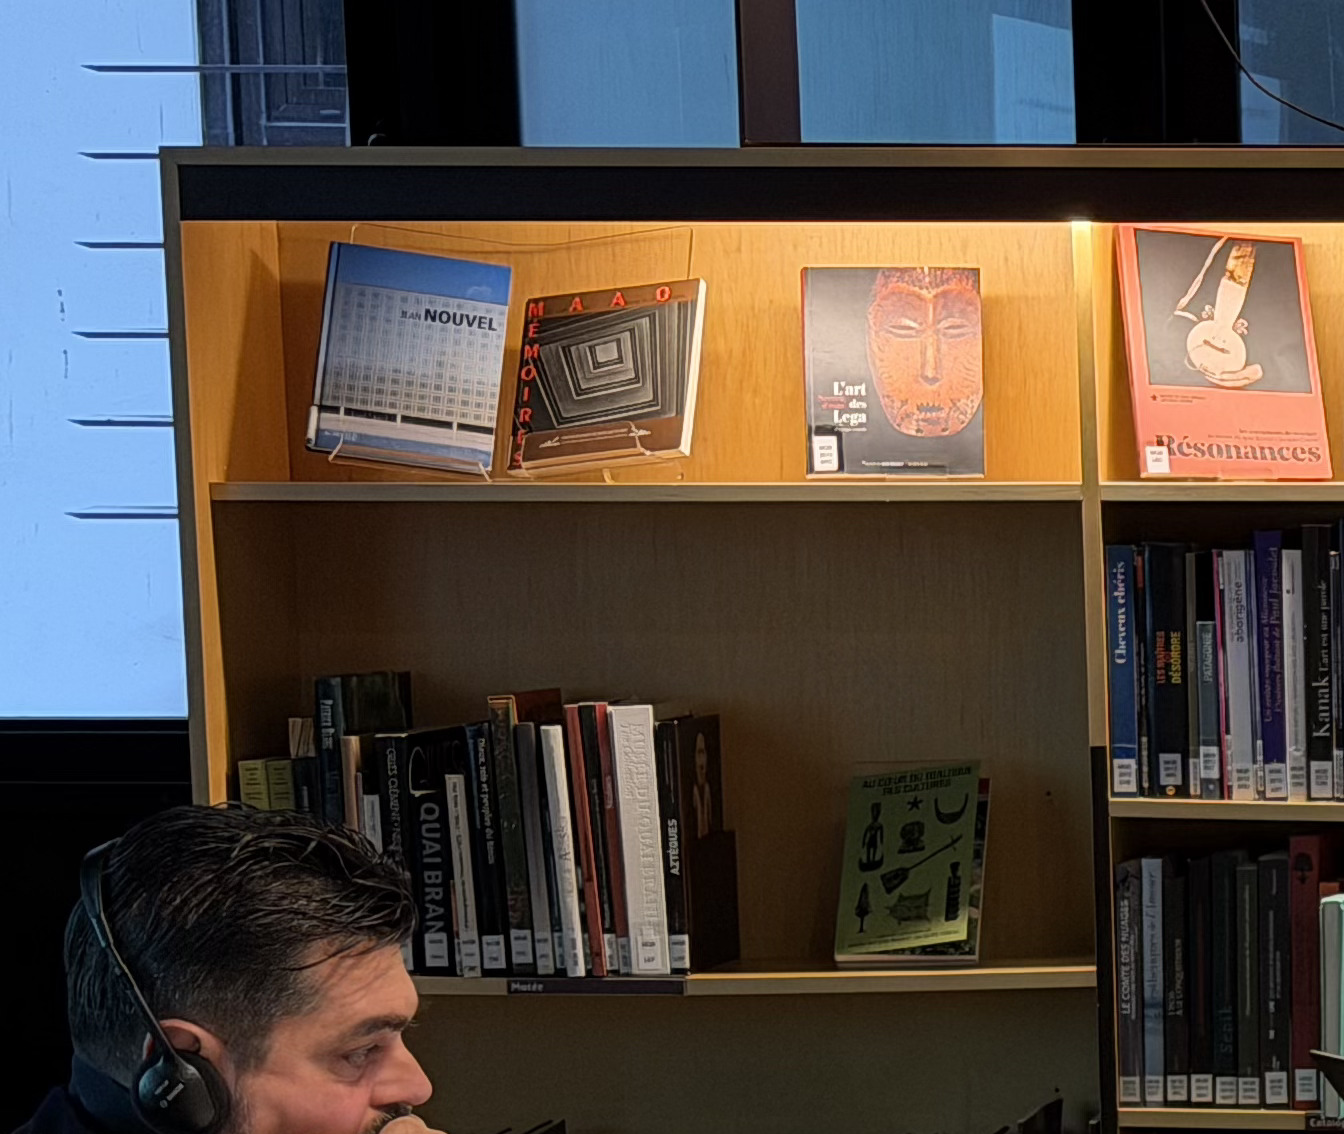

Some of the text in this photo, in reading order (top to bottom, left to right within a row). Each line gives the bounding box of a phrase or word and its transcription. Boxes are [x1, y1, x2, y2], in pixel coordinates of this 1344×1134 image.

[424, 307, 498, 332] NOUVEL
[833, 381, 866, 396] L'art
[833, 410, 867, 426] Lega
[849, 399, 867, 409] des
[1155, 435, 1321, 463] Résonances
[1114, 560, 1127, 664] Cheveux chéris
[1234, 581, 1245, 644] aborigène
[1170, 631, 1182, 684] DÉSORDRE
[1312, 676, 1330, 738] Kanak
[667, 818, 681, 876] AZTÈQUES
[419, 801, 446, 934] QUAI BRAN
[1120, 943, 1130, 964] DES
[1122, 1003, 1131, 1015] LE
